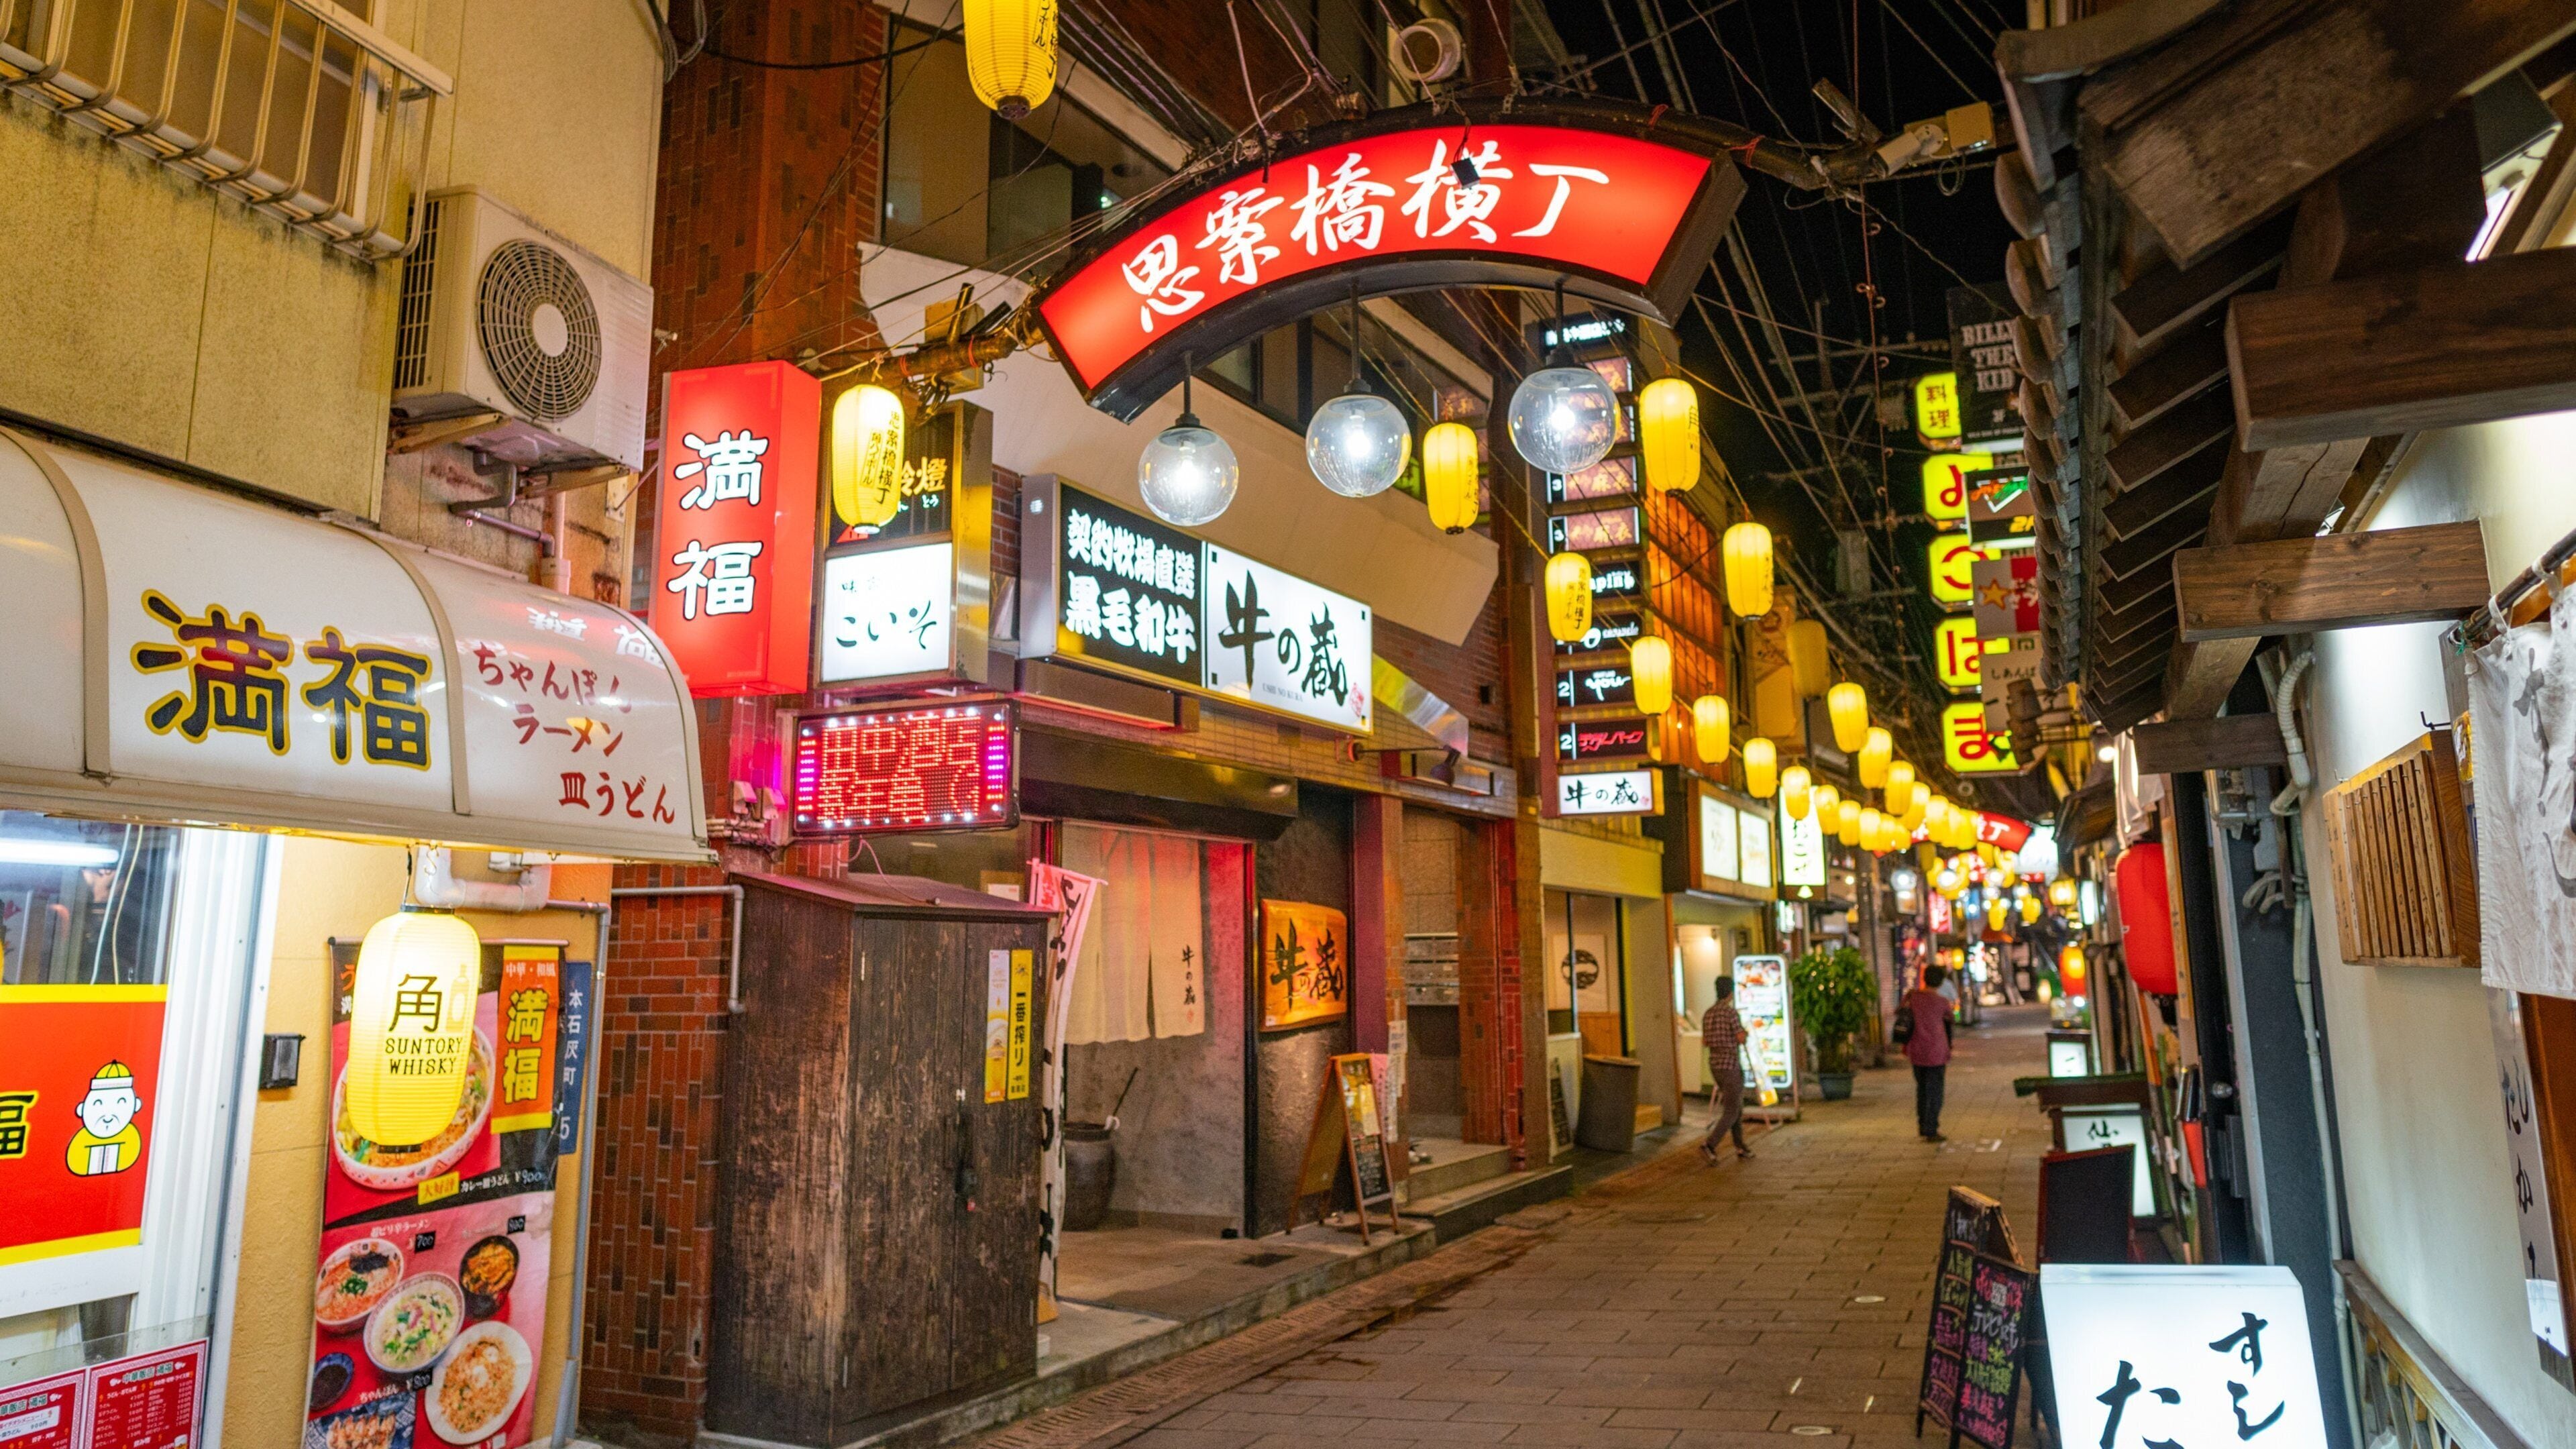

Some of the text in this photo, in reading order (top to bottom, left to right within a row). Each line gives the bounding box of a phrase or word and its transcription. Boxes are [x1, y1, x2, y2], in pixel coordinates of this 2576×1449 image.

[1120, 138, 1610, 333] 思案橋横丁
[1976, 368, 2015, 392] KID
[666, 429, 770, 621] 満福
[1067, 508, 1195, 600] 契約牧場直送
[836, 600, 937, 650] こいそ
[1065, 570, 1197, 664] 黒毛和牛
[1218, 569, 1348, 708] 牛の蔵
[131, 588, 432, 771] 満福
[472, 641, 632, 714] ちゃんぽん
[1558, 681, 1570, 698] 2
[513, 704, 623, 757] ラーメン
[1560, 733, 1572, 750] 2
[558, 771, 676, 824] 皿うどん
[1564, 776, 1639, 810] 牛の蔵
[388, 973, 443, 1032] 角
[1181, 944, 1197, 1006] 牛の蔵
[384, 1036, 463, 1055] SUNTORY
[389, 1056, 457, 1075] WHISKY
[502, 987, 549, 1104] 満福
[562, 989, 583, 1086] 本石灰町
[2208, 1311, 2285, 1442] すし
